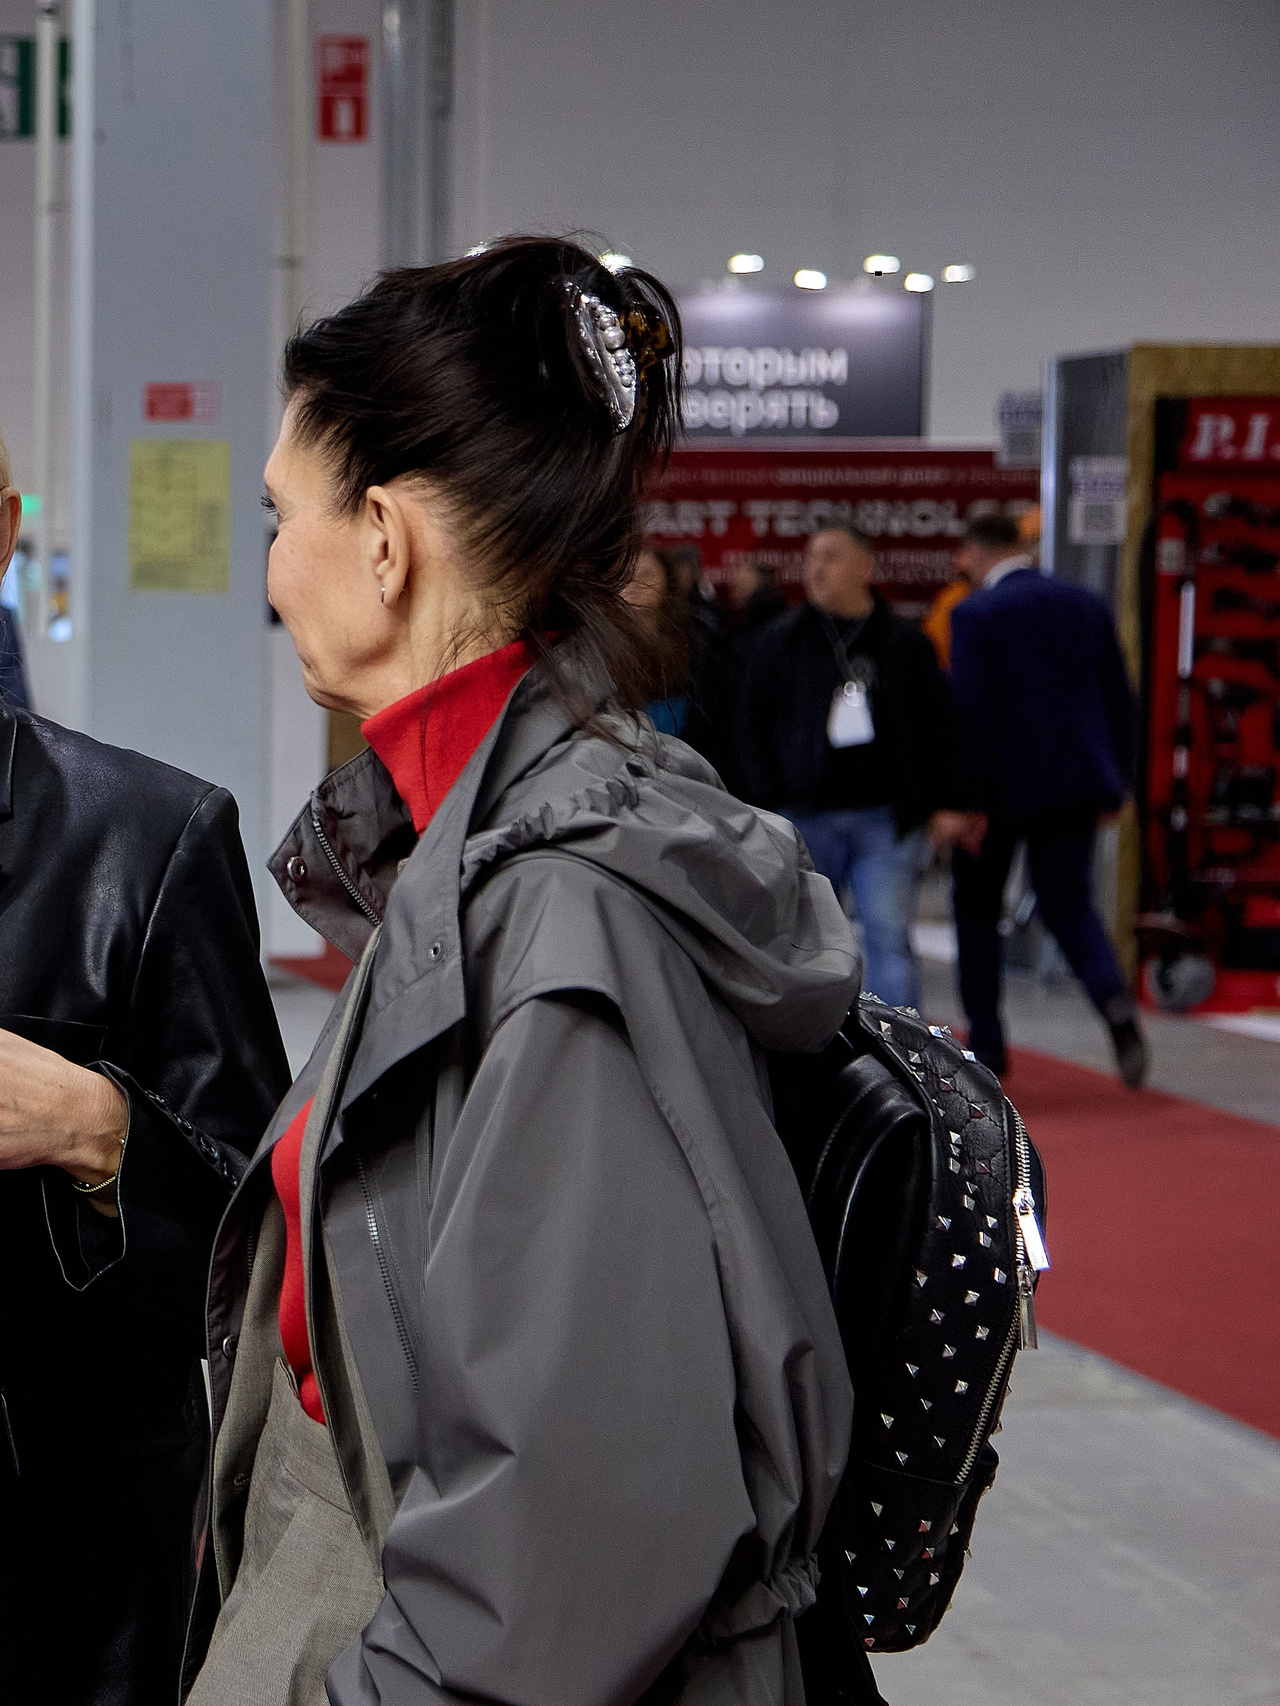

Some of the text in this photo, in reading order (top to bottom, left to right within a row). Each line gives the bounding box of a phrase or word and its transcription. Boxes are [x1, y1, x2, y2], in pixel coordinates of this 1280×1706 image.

[681, 346, 849, 392] оторым
[680, 388, 840, 437] верять
[642, 500, 736, 538] ART
